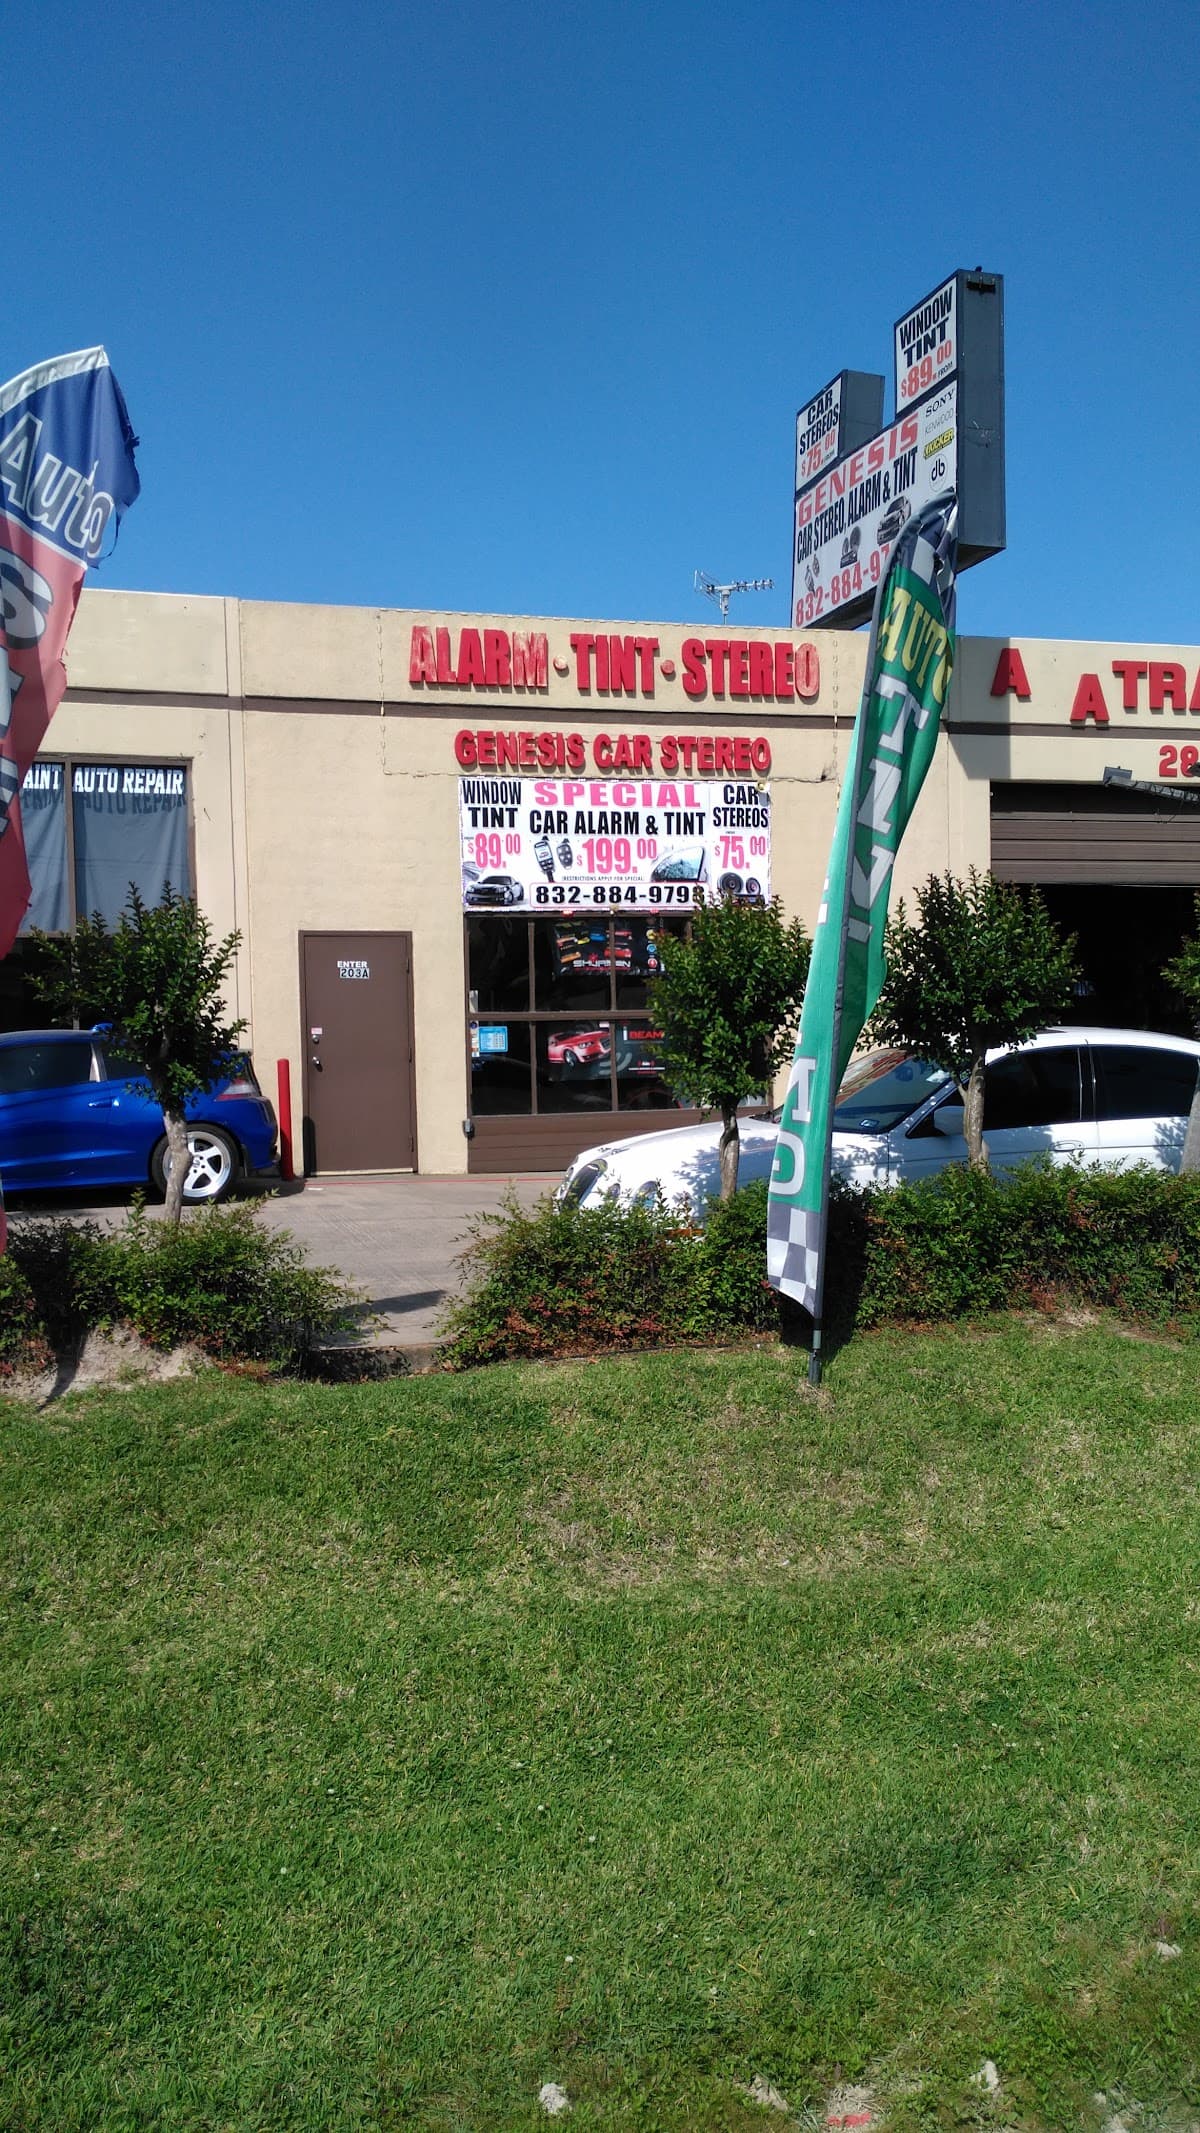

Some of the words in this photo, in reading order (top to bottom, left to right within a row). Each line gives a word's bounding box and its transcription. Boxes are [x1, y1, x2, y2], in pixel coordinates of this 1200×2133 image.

[900, 286, 952, 349] WINDOW
[904, 317, 949, 368] TINT
[938, 361, 953, 377] FROM
[807, 389, 833, 426] CAR
[925, 389, 954, 417] SONY
[800, 403, 838, 455] STEREOS
[925, 408, 954, 434] KENWOOD
[798, 411, 919, 528] GENESIS
[797, 521, 813, 564] CAR
[814, 497, 846, 550] STEREO,
[848, 470, 881, 528] ALARM
[883, 470, 890, 501] &
[893, 446, 918, 496] TINT
[409, 625, 547, 687] ALARM
[571, 634, 659, 692] TINT
[682, 638, 820, 697] STEREO
[454, 730, 584, 767] GENESIS
[593, 734, 653, 769] CAR
[660, 736, 771, 770] STEREO
[74, 767, 118, 793] AUTO
[123, 768, 184, 795] REPAIR
[463, 780, 521, 805] WINDOW
[534, 782, 700, 807] SPECIAL
[723, 784, 759, 805] CAR
[468, 807, 518, 828] TINT
[530, 809, 568, 834] CAR
[574, 810, 639, 835] ALARM
[646, 815, 658, 835] &
[664, 811, 706, 835] TINT
[713, 806, 768, 828] STEREOS
[536, 886, 705, 904] 832-884-9798
[341, 968, 369, 978] 203A
